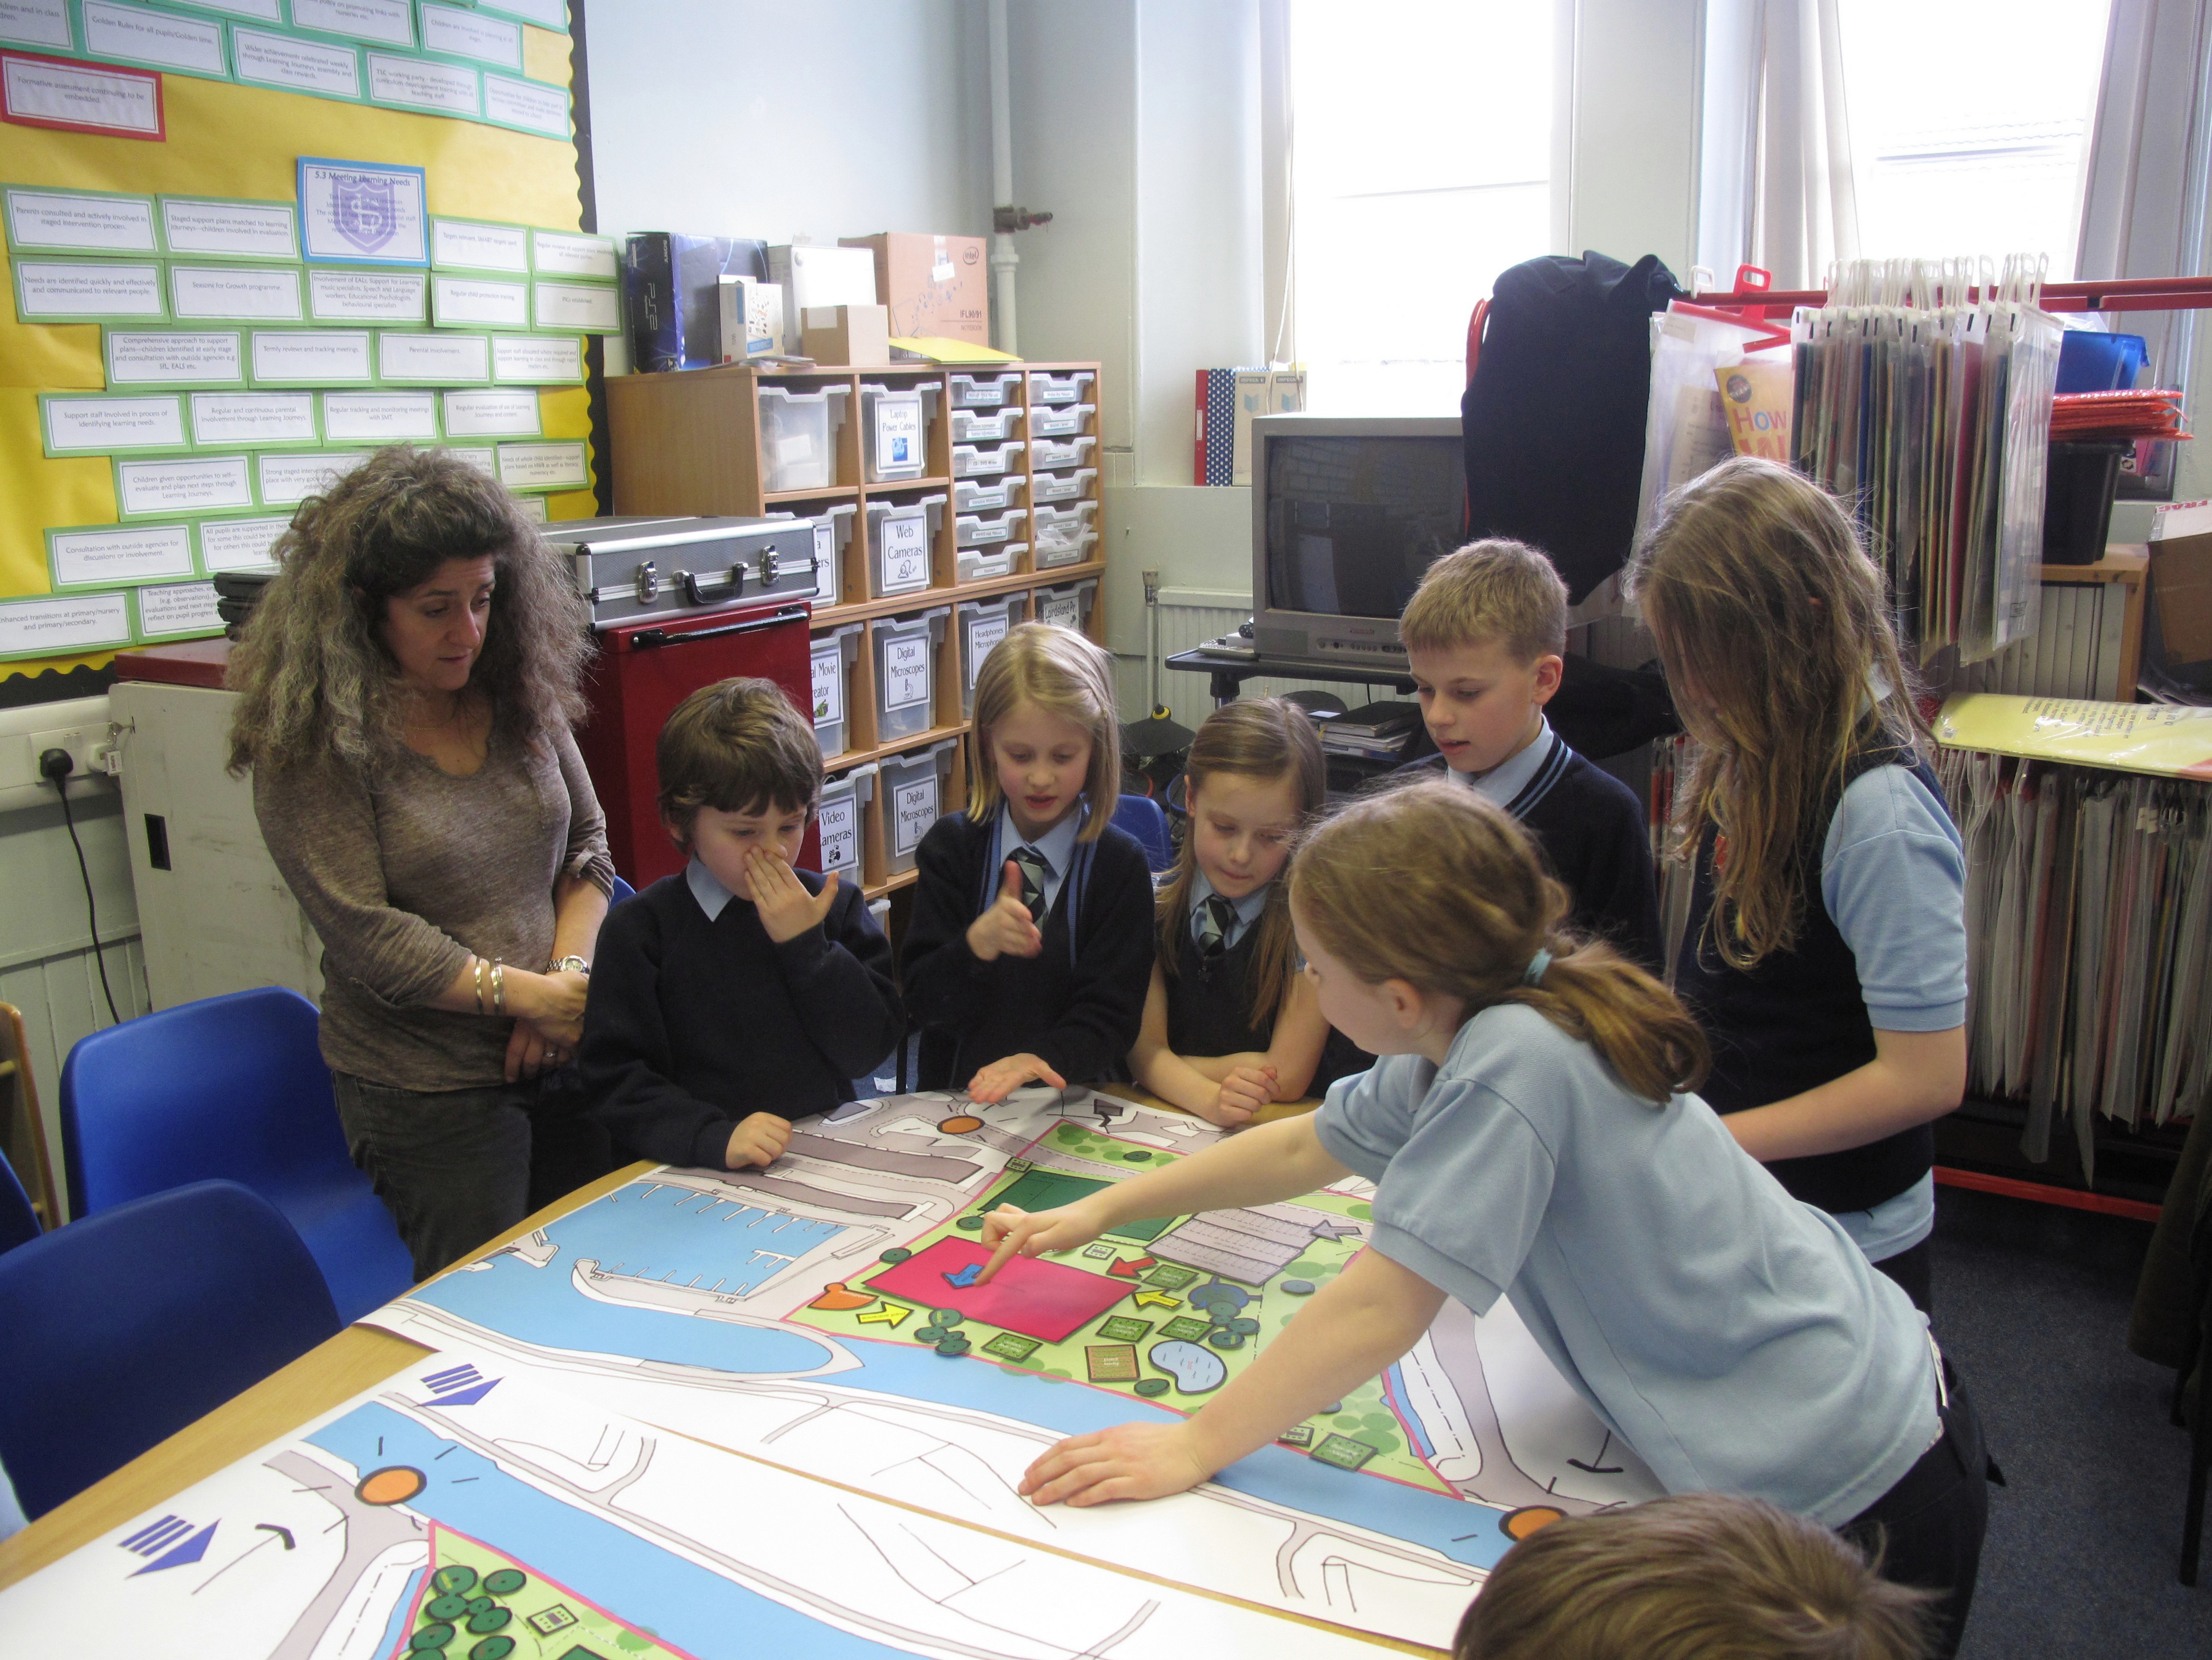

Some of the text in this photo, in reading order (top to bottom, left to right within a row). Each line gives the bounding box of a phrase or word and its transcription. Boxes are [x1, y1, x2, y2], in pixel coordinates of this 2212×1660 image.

[315, 171, 411, 186] 5.3 Meeting Learning Needs
[964, 250, 977, 260] intel
[960, 309, 982, 319] IFL90/91
[890, 409, 908, 420] Laptop
[1733, 407, 1787, 433] How
[882, 421, 916, 431] Power Cables
[896, 524, 914, 539] Web
[65, 544, 105, 553] Consultation
[121, 541, 143, 550] outside
[145, 540, 168, 550] agencies
[888, 544, 923, 558] Cameras
[0, 614, 28, 622] nhanced
[975, 627, 1004, 639] Headphones
[975, 639, 1001, 649] Microphon
[897, 647, 916, 660] Digital
[819, 662, 836, 677] Movie
[890, 663, 925, 679] Microscopes
[812, 685, 830, 699] eator
[906, 789, 925, 805] Digital
[821, 811, 845, 826] Video
[900, 805, 934, 822] Microscopes
[821, 829, 852, 847] ameras
